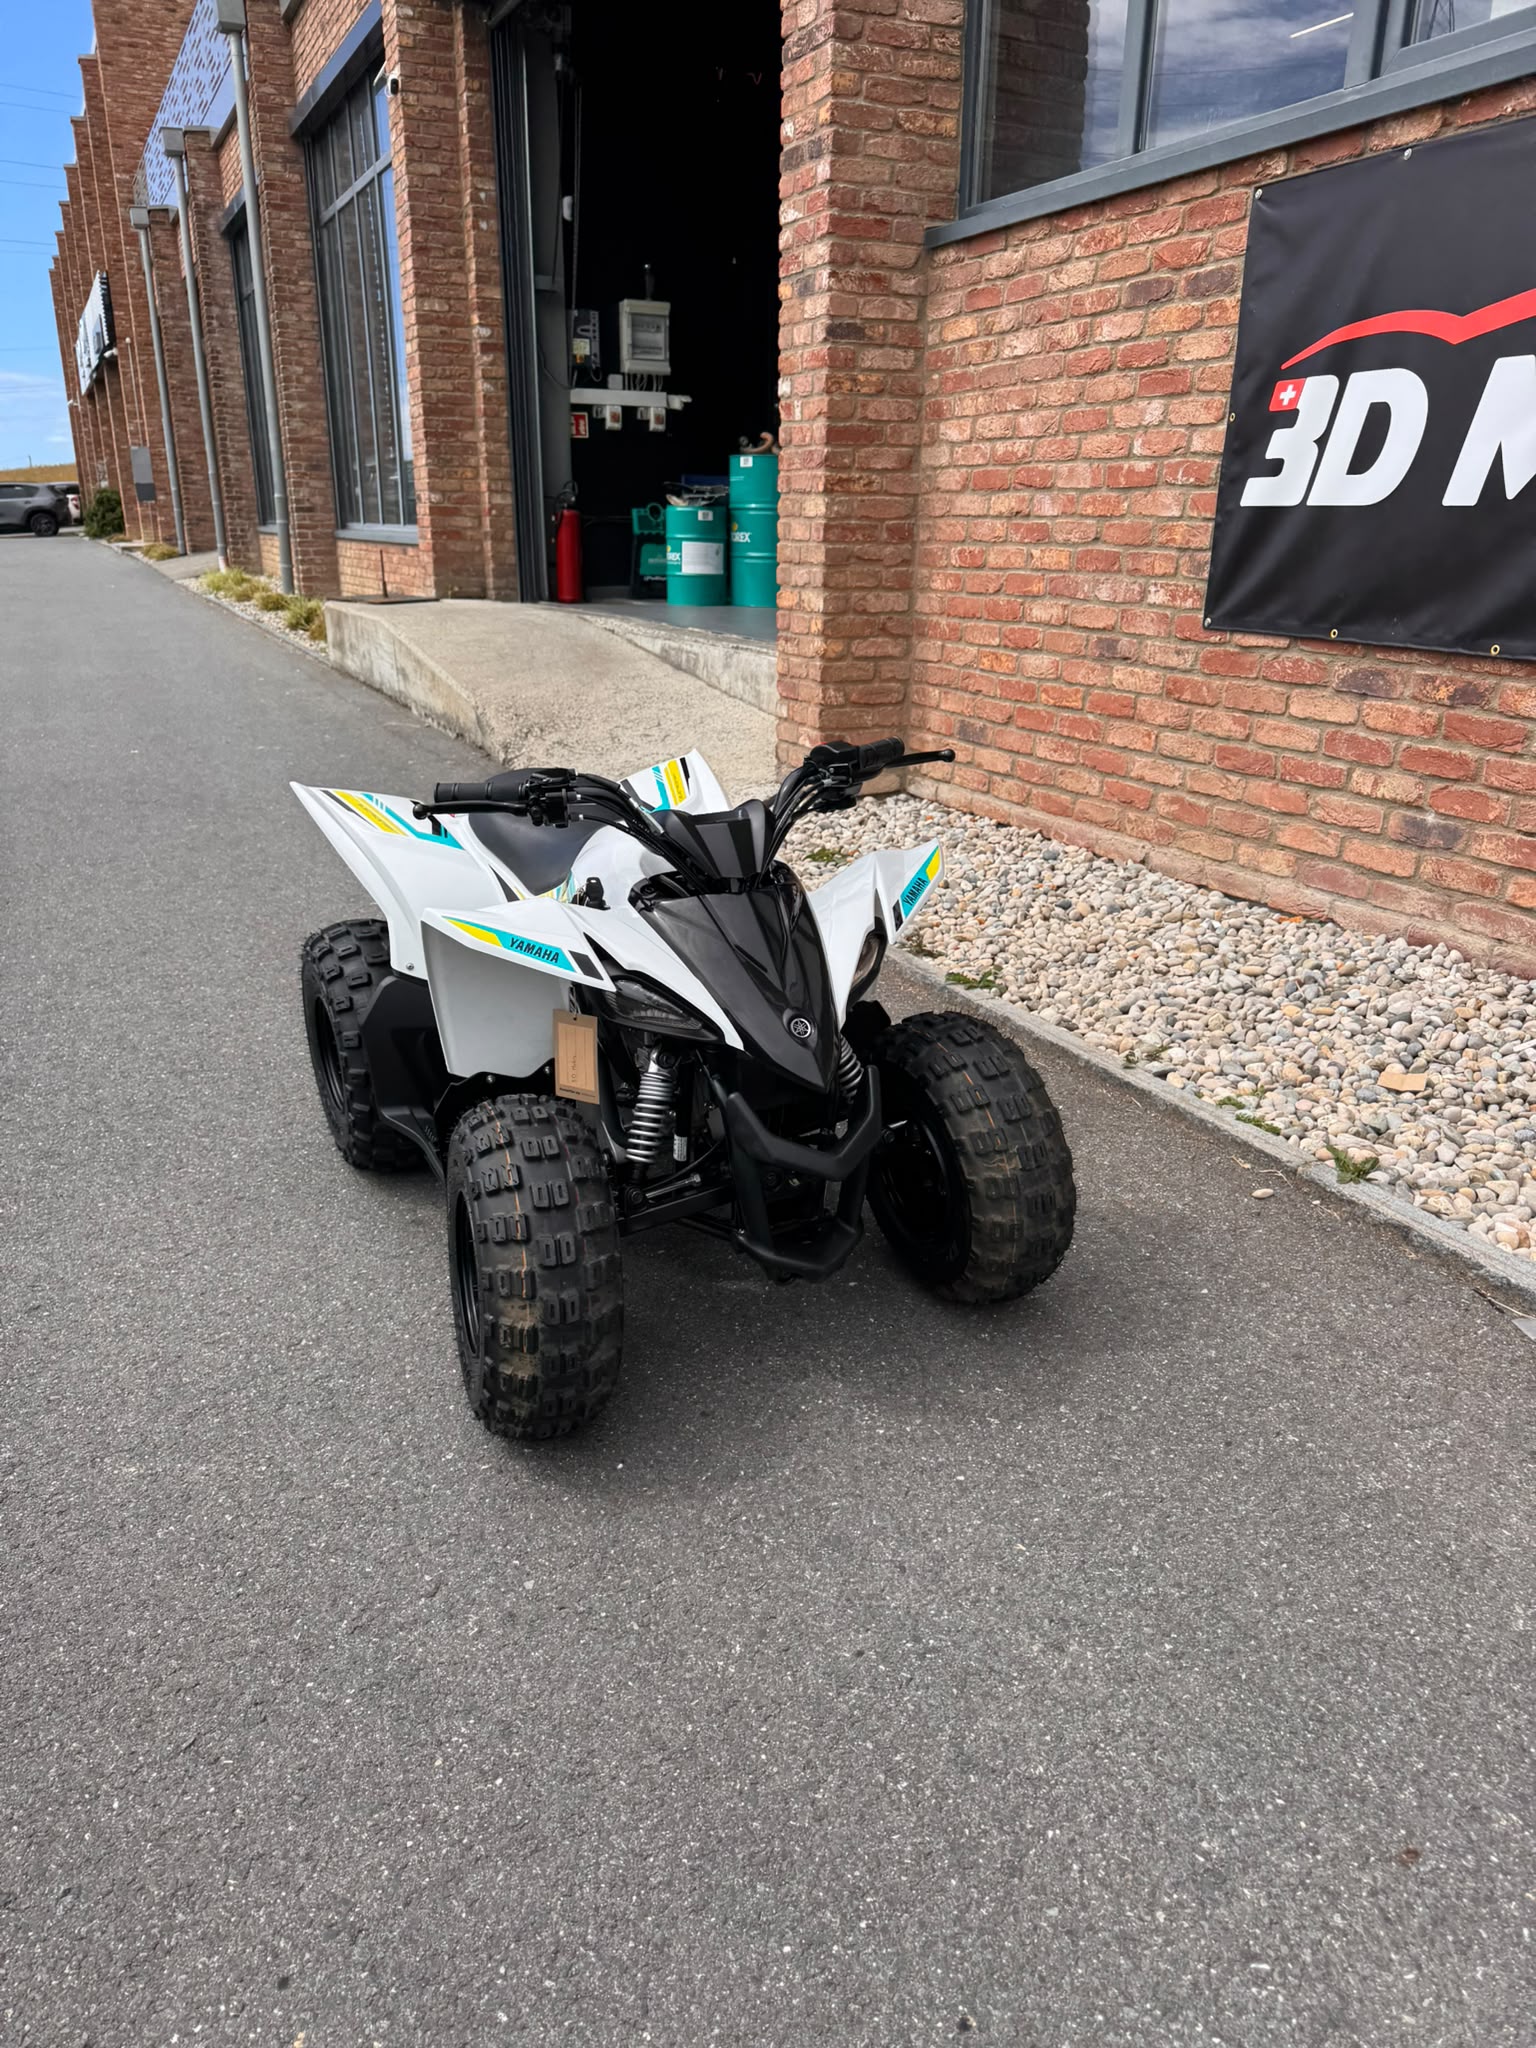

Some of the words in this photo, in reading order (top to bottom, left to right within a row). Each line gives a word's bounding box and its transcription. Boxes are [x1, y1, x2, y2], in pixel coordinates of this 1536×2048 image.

[1239, 368, 1429, 507] 3D
[903, 877, 928, 906] YAMAHA
[510, 936, 559, 963] YAMAHA
